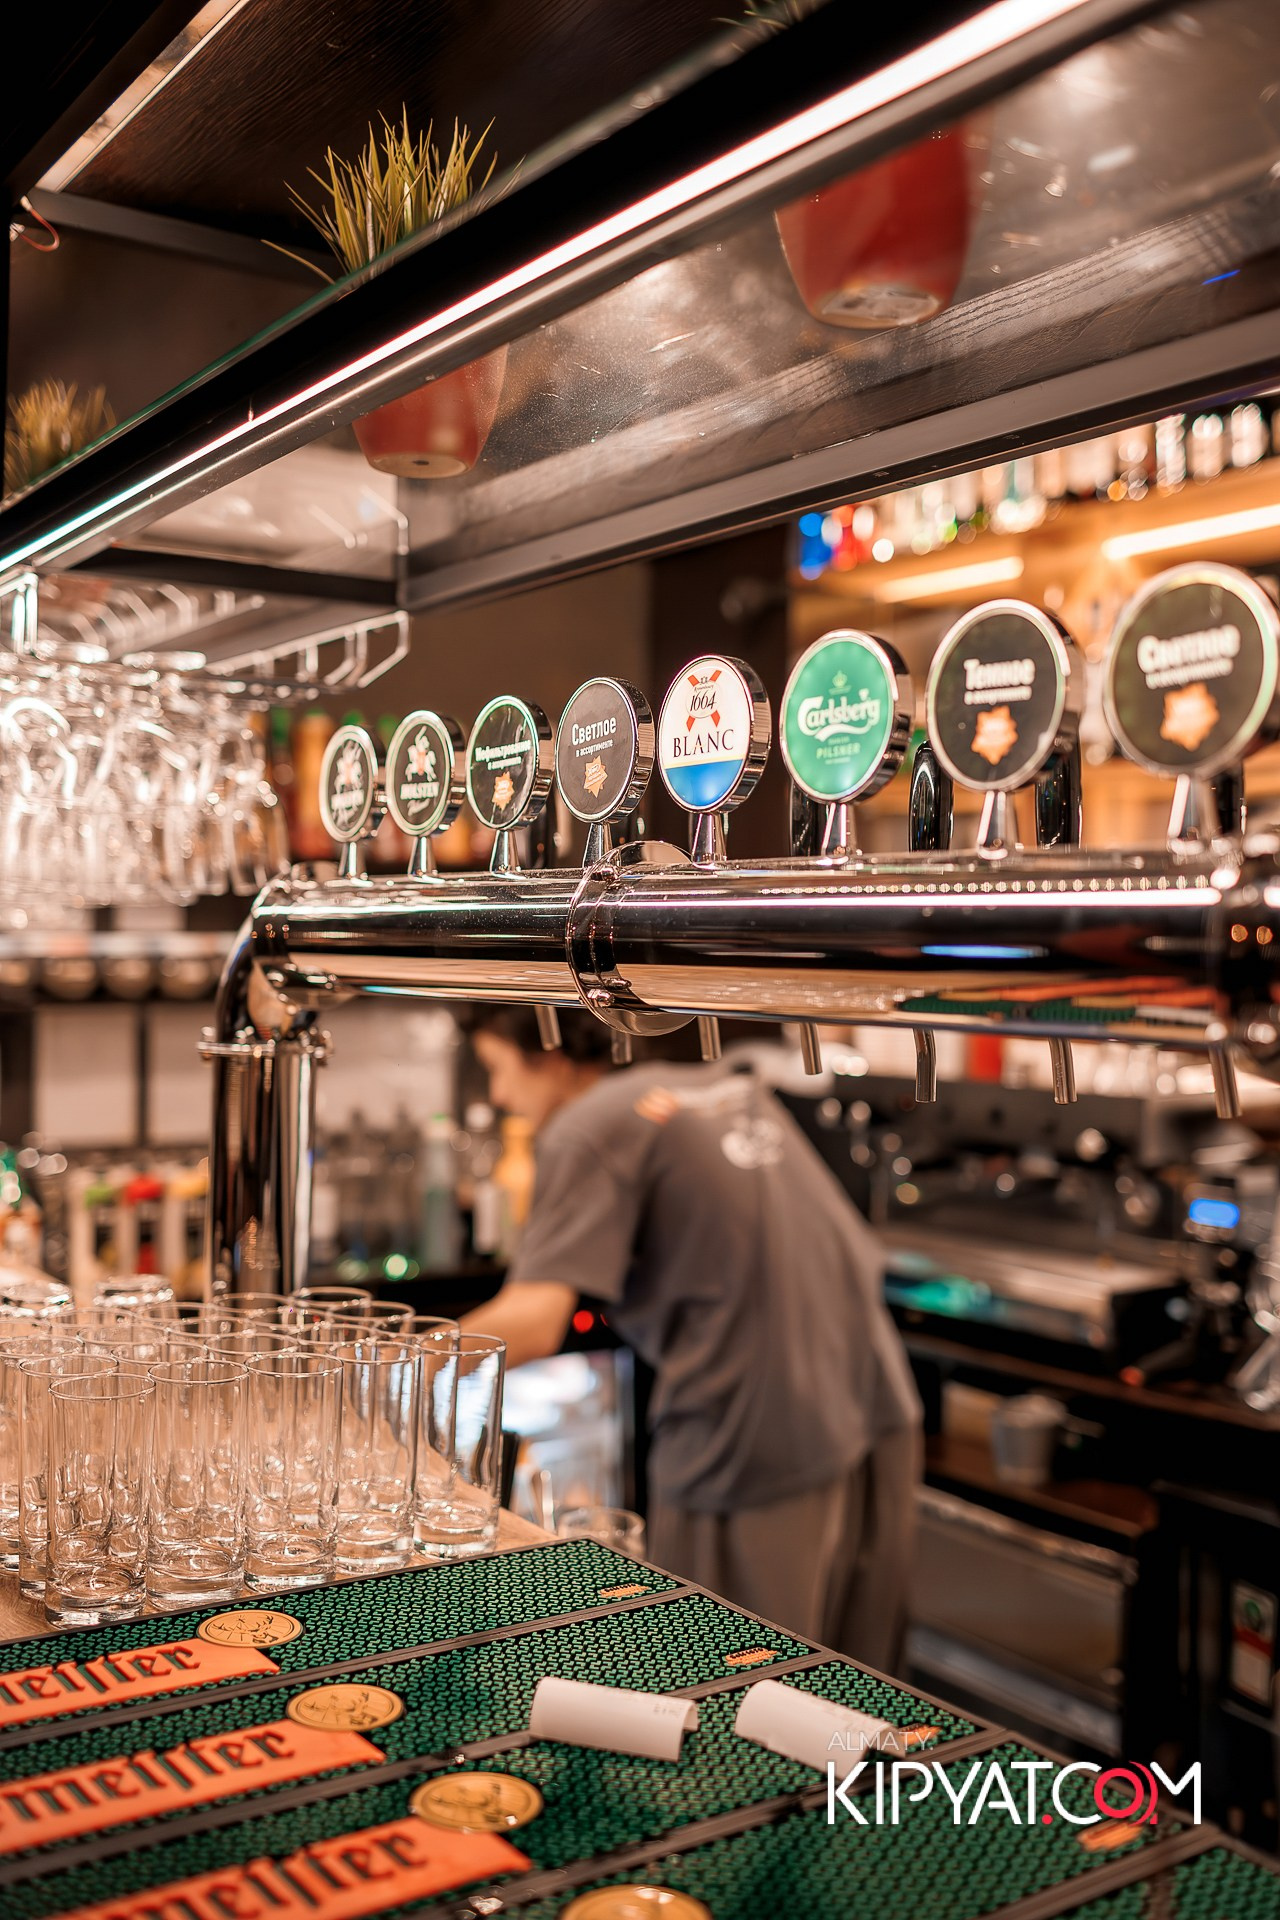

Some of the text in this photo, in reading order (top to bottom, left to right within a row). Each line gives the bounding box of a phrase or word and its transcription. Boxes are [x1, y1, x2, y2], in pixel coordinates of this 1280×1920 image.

[689, 690, 717, 712] 1664
[797, 688, 881, 742] Carlsberg
[571, 717, 617, 746] Светлое
[673, 728, 734, 758] BLANC
[580, 739, 614, 756] ассортименте
[0, 1728, 296, 1832] meister
